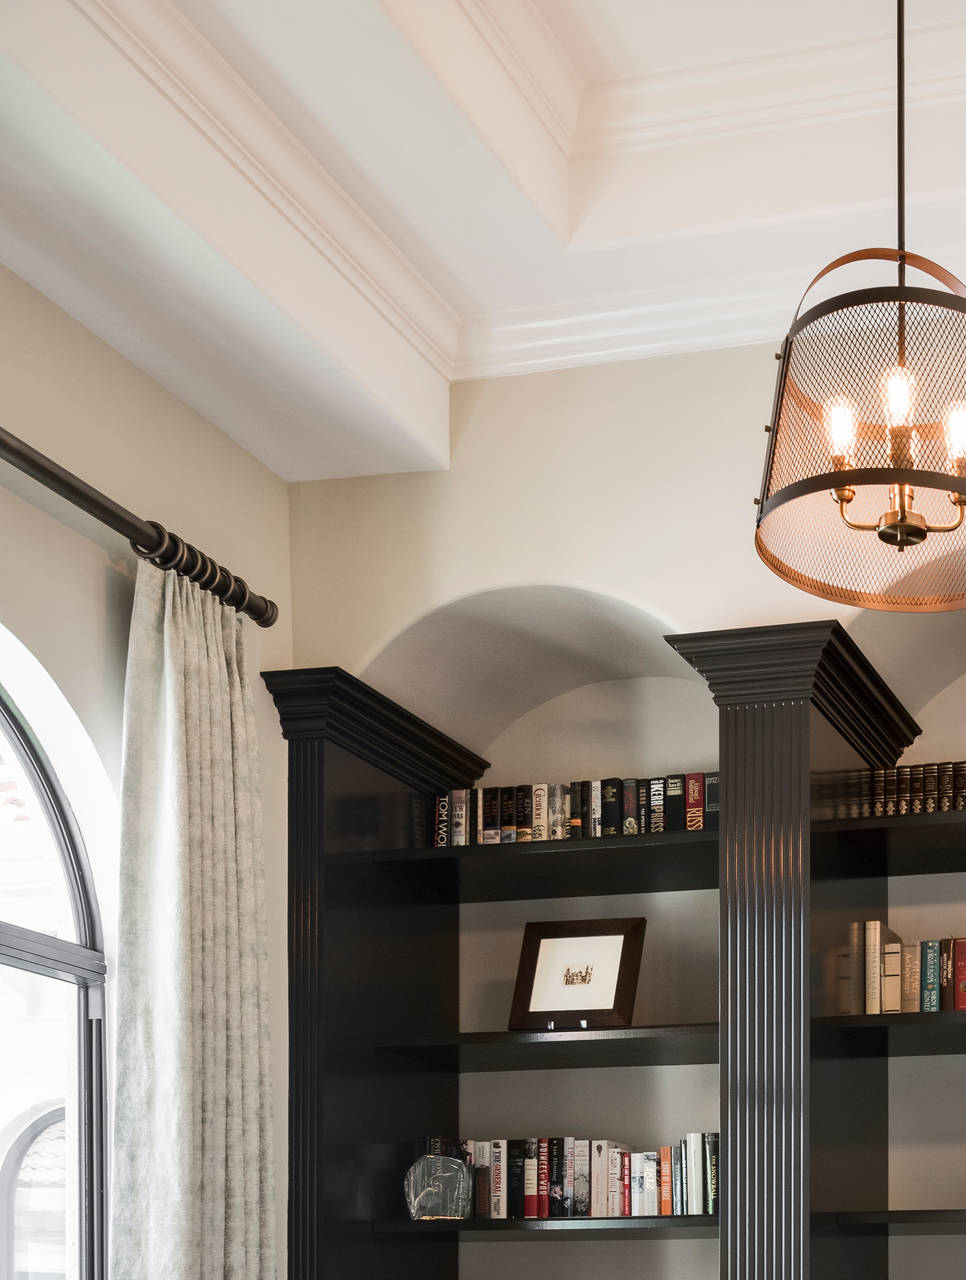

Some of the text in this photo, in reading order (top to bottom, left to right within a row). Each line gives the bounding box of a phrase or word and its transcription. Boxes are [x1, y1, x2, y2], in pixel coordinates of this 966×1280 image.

[439, 795, 449, 821] TOM
[534, 788, 547, 820] Creation
[650, 785, 665, 833] KERR PRUSS
[686, 807, 704, 831] RUSS
[494, 1150, 502, 1194] THE GENERAL
[538, 1142, 548, 1174] PRINCES
[538, 1180, 548, 1196] WAR
[711, 1163, 719, 1200] SNOWBALL
